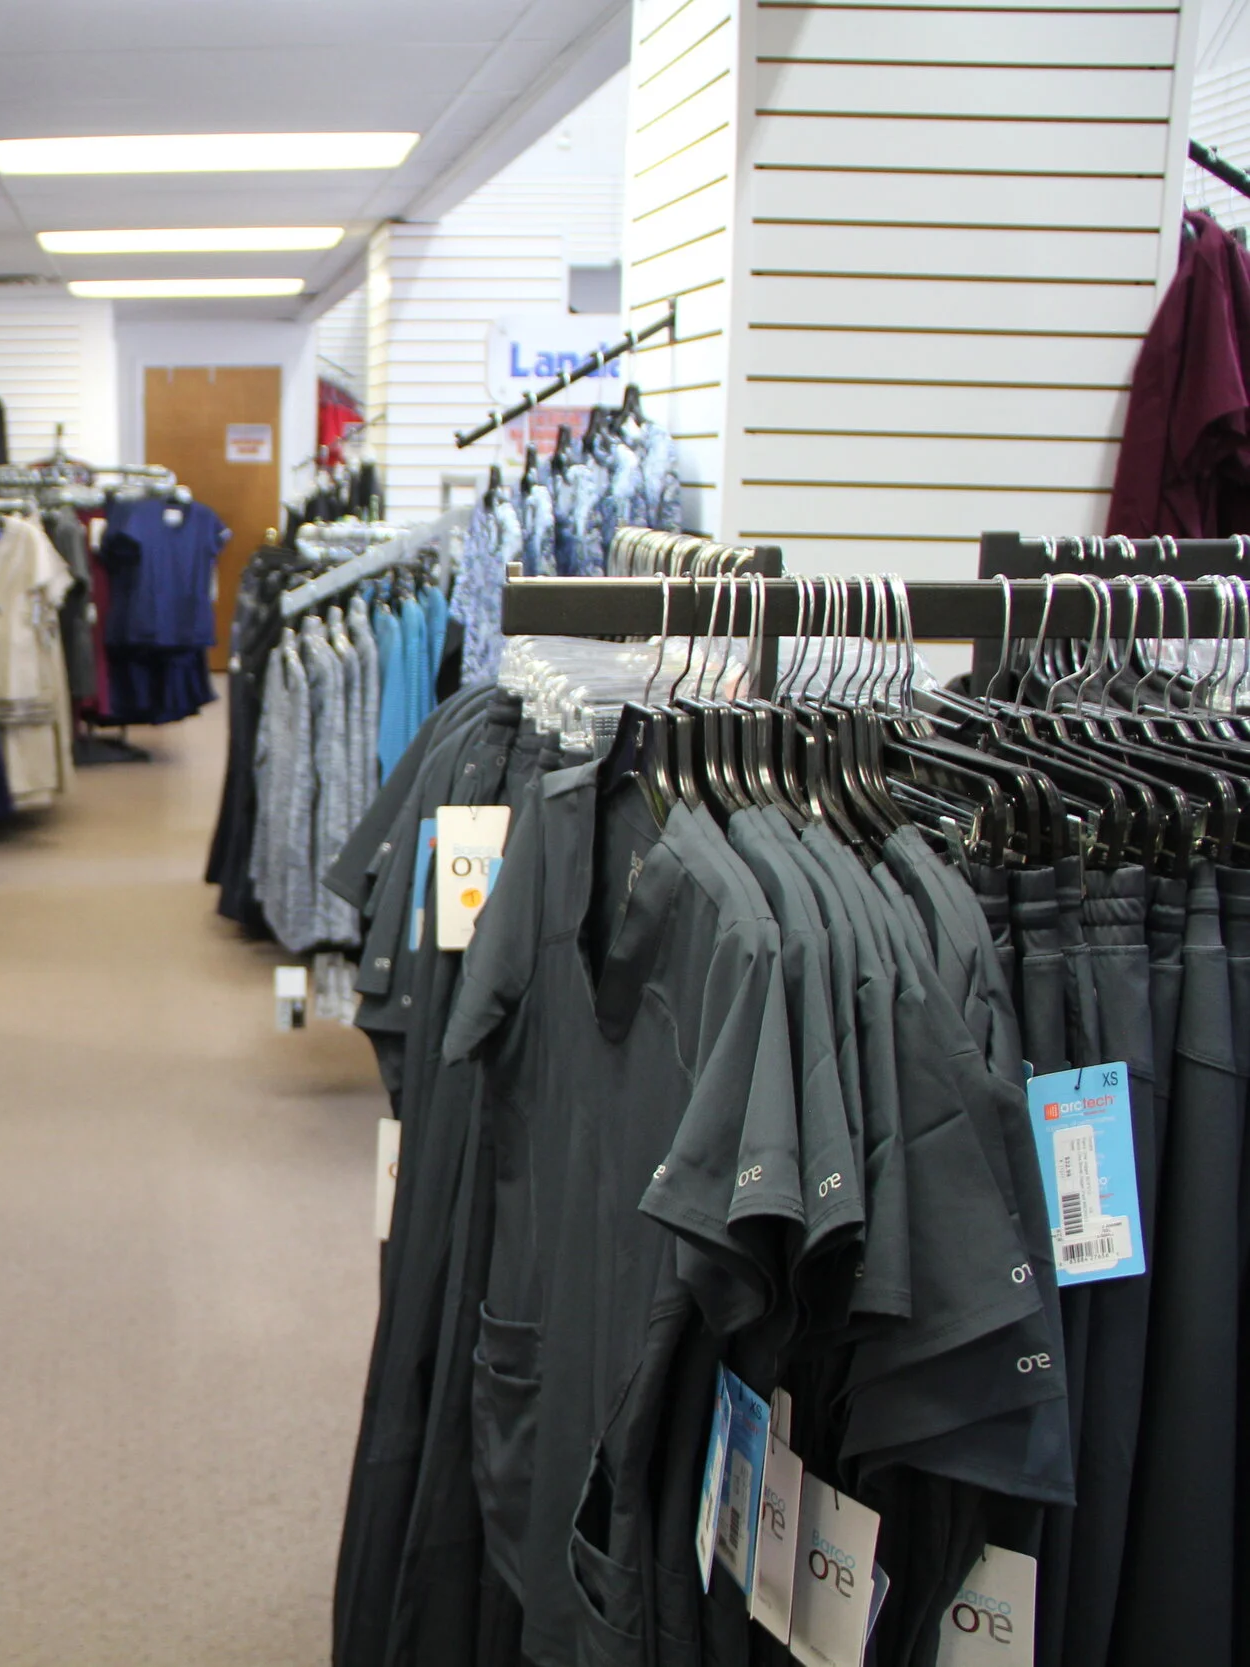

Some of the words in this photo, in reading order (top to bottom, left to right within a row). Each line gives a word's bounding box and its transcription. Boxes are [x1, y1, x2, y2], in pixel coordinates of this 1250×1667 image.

[1102, 1071, 1119, 1088] XS
[1011, 1263, 1033, 1284] on
[811, 1528, 856, 1570] Barco
